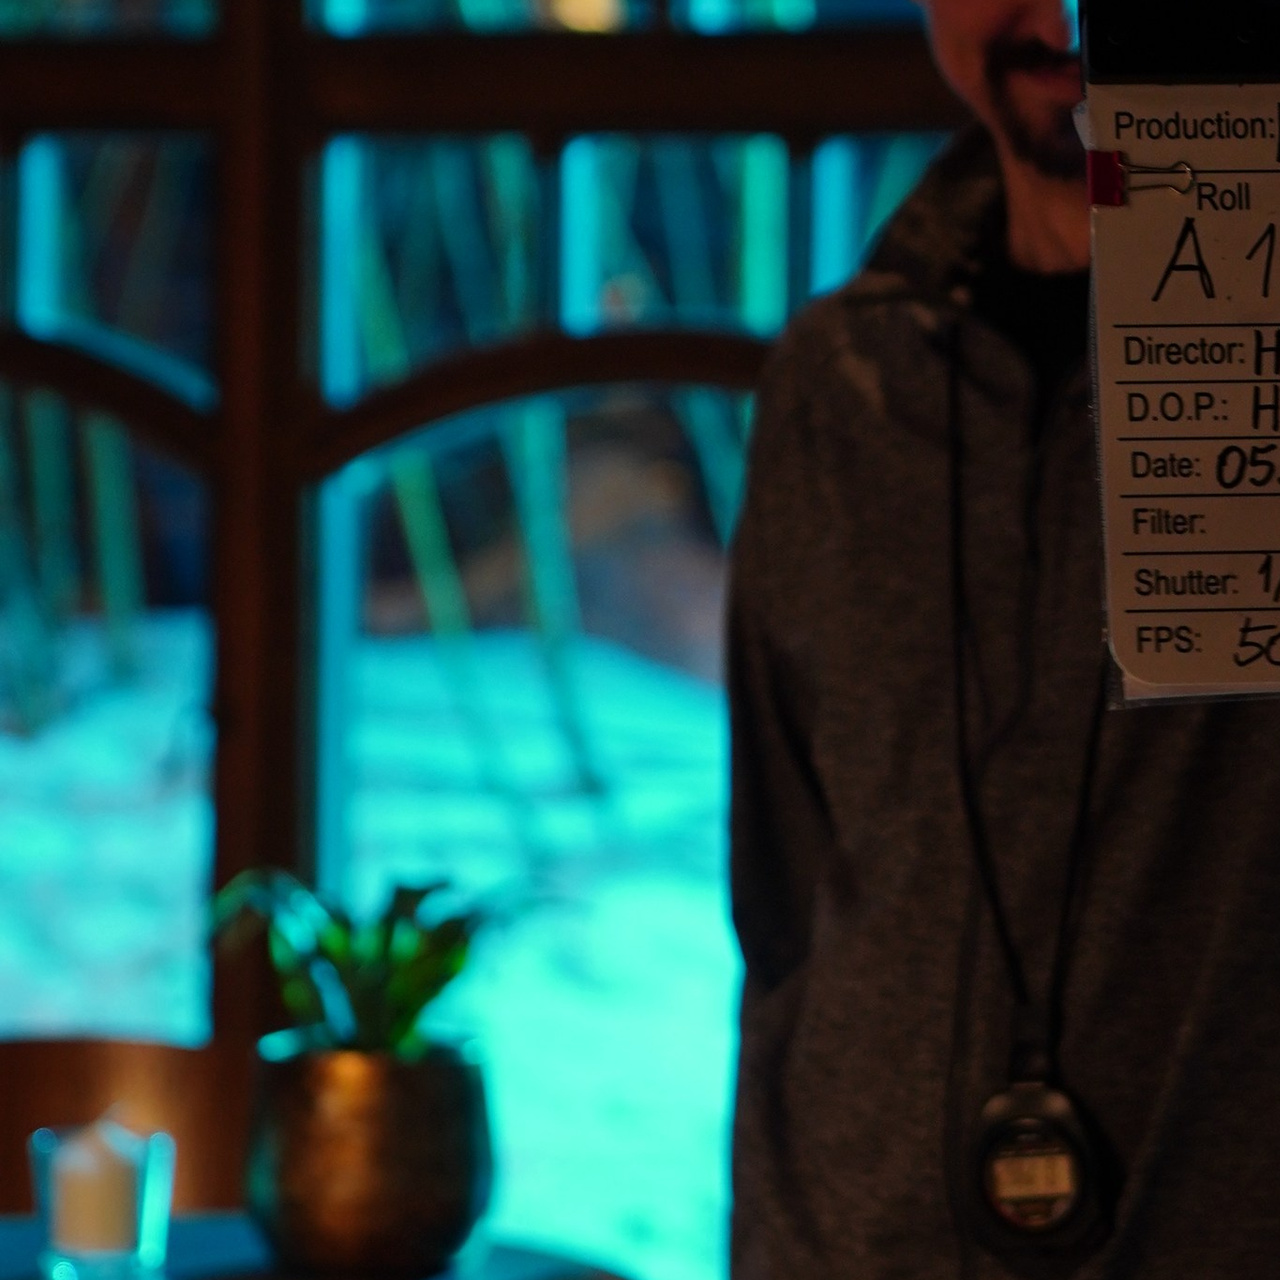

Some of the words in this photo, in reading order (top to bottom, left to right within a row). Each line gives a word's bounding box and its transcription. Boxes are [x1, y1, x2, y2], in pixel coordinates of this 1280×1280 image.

[1115, 111, 1276, 141] Production:
[1198, 182, 1251, 211] Roll
[1124, 336, 1246, 366] Director:
[1127, 392, 1229, 422] D.O.P.:
[1131, 451, 1202, 479] Date:
[1132, 507, 1206, 535] Filter:
[1135, 568, 1239, 596] Shutter:
[1136, 626, 1201, 654] FPS:
